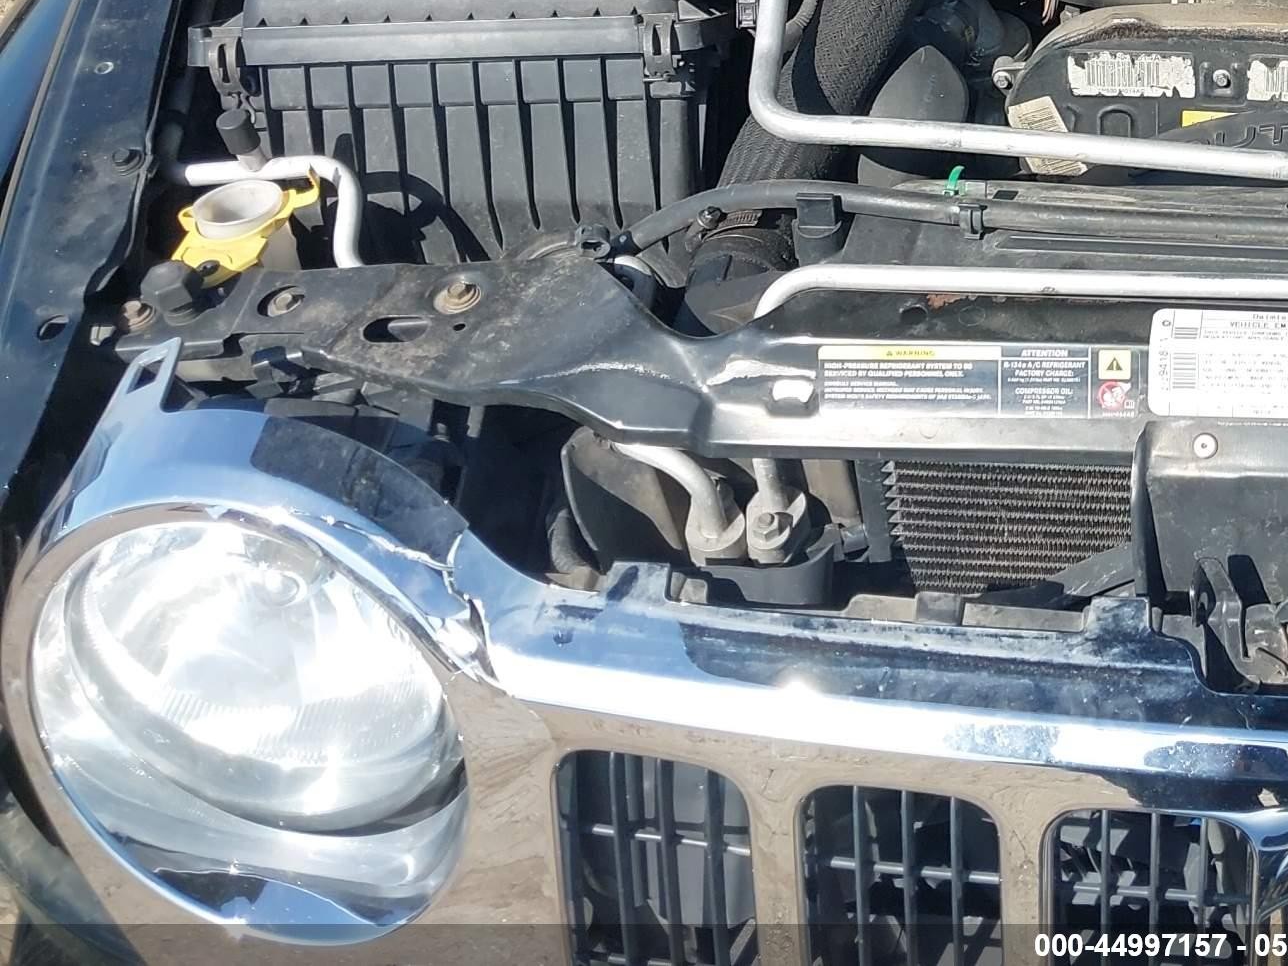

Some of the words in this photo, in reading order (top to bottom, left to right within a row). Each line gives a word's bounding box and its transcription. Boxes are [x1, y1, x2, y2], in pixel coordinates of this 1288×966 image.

[1230, 321, 1269, 329] VEHICLE
[1021, 349, 1068, 357] ATTENTION
[1015, 387, 1059, 395] COMPRESSOR
[1060, 387, 1074, 395] OIL:
